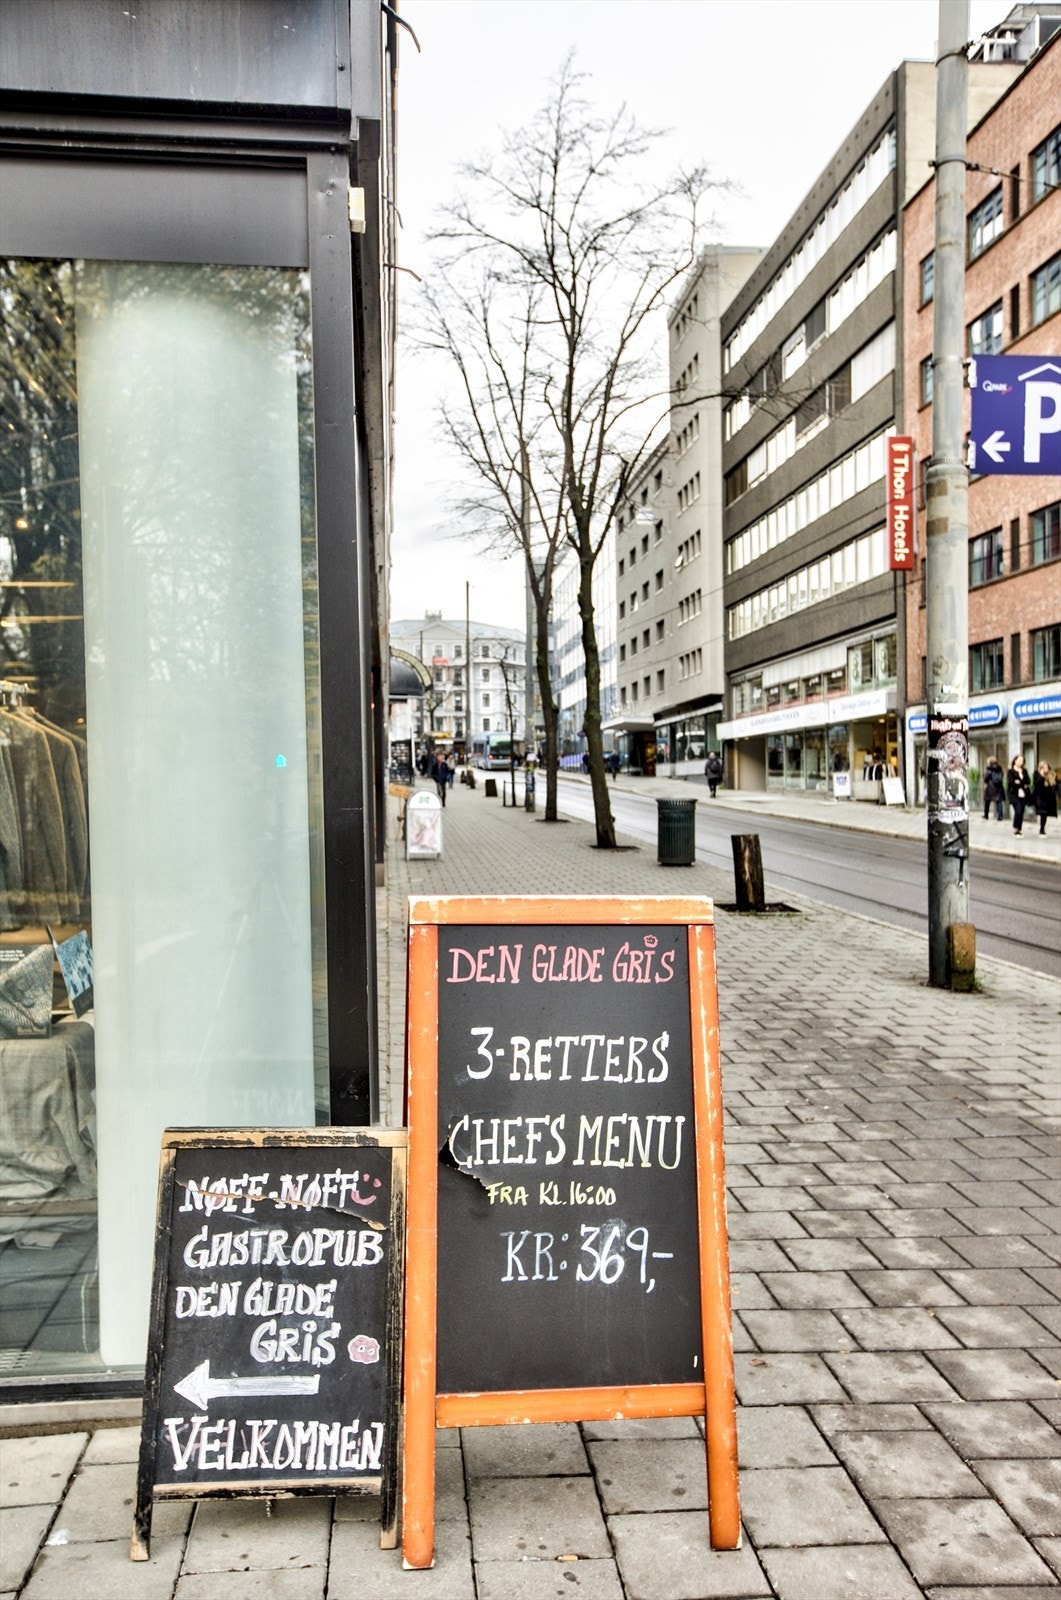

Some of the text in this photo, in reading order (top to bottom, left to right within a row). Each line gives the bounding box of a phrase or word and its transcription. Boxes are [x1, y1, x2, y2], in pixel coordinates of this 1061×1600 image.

[893, 454, 909, 562] Thon Hotels
[447, 936, 675, 984] DEN GLADE GRIS
[466, 1026, 670, 1084] 3-RETTERS
[448, 1113, 686, 1170] CHEFS MENU
[486, 1182, 529, 1206] FRA
[183, 1224, 384, 1270] GASTROPUB
[175, 1277, 338, 1319] DEN GLADE
[164, 1415, 385, 1472] VELKOMMEN
